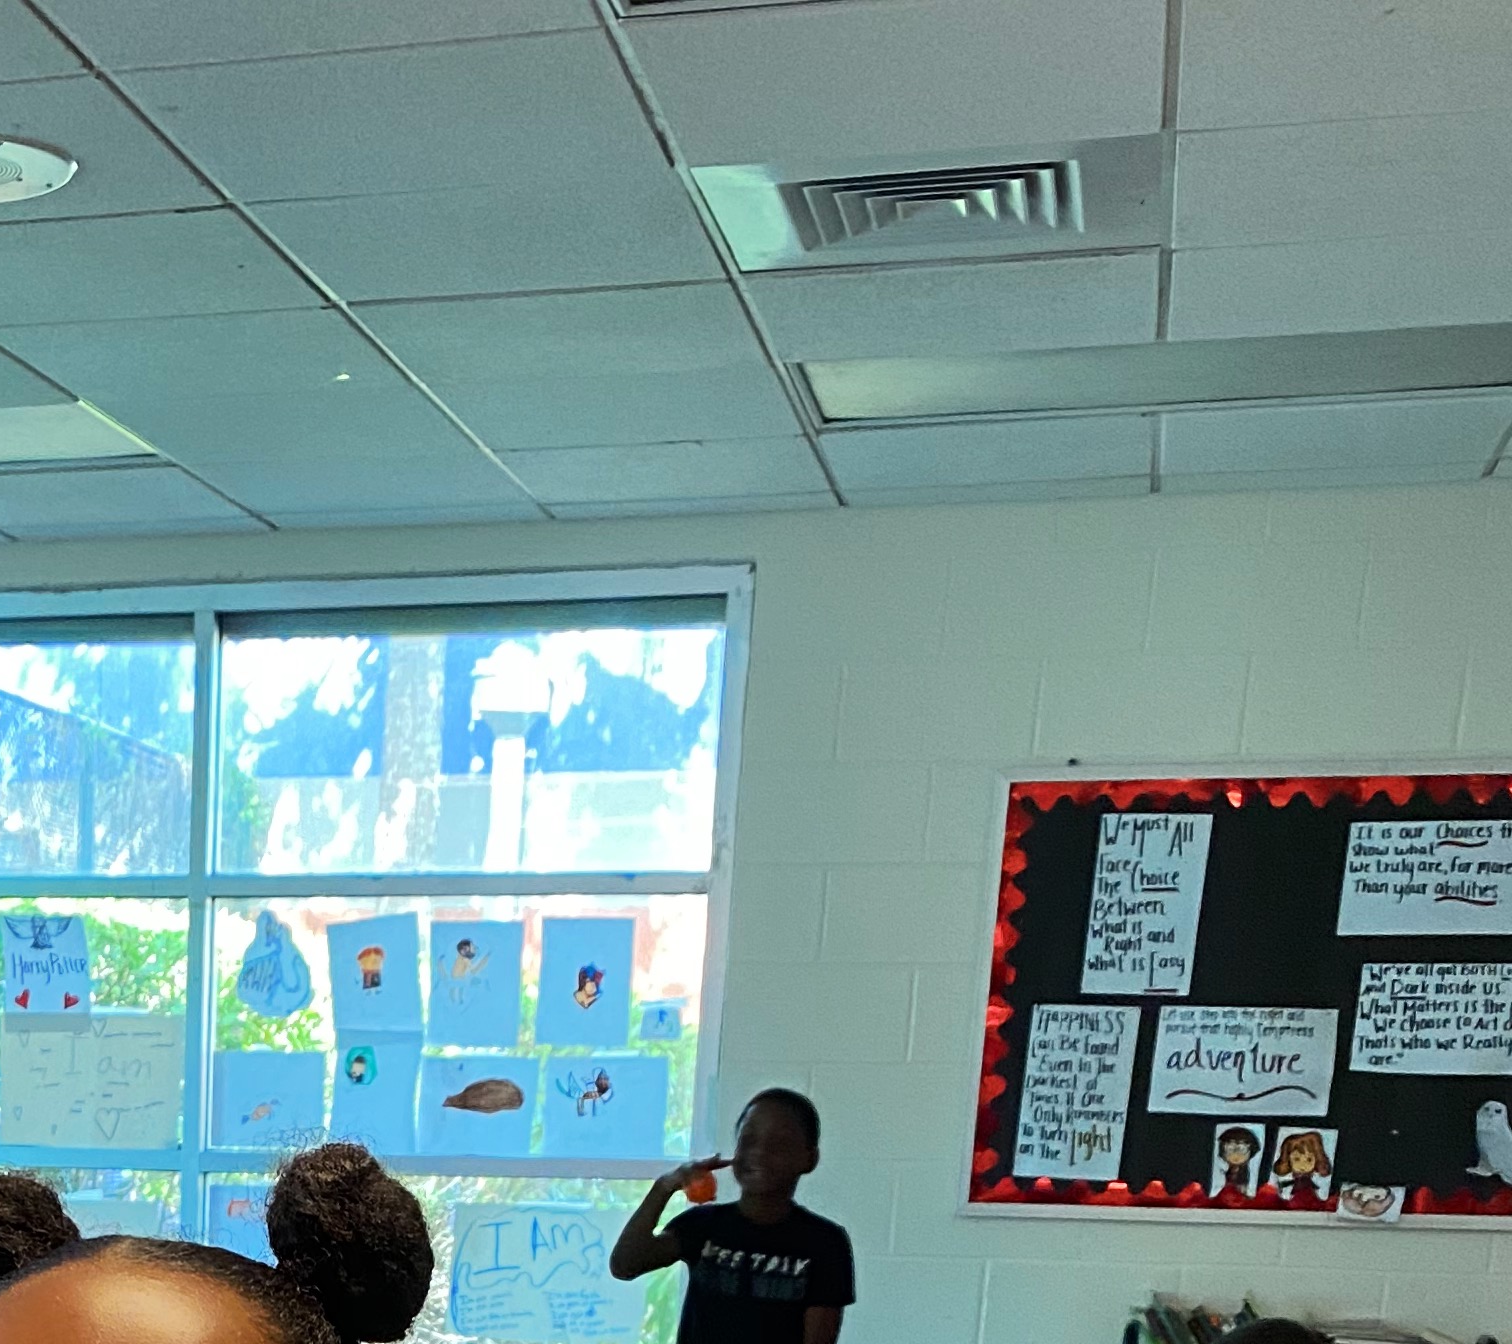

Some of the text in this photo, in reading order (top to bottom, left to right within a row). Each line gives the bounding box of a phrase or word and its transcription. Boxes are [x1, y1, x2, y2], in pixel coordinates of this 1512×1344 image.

[1168, 821, 1194, 857] All
[1399, 827, 1425, 839] our
[12, 952, 51, 985] Harry
[1167, 1038, 1305, 1082] adventure
[474, 1221, 520, 1275] I
